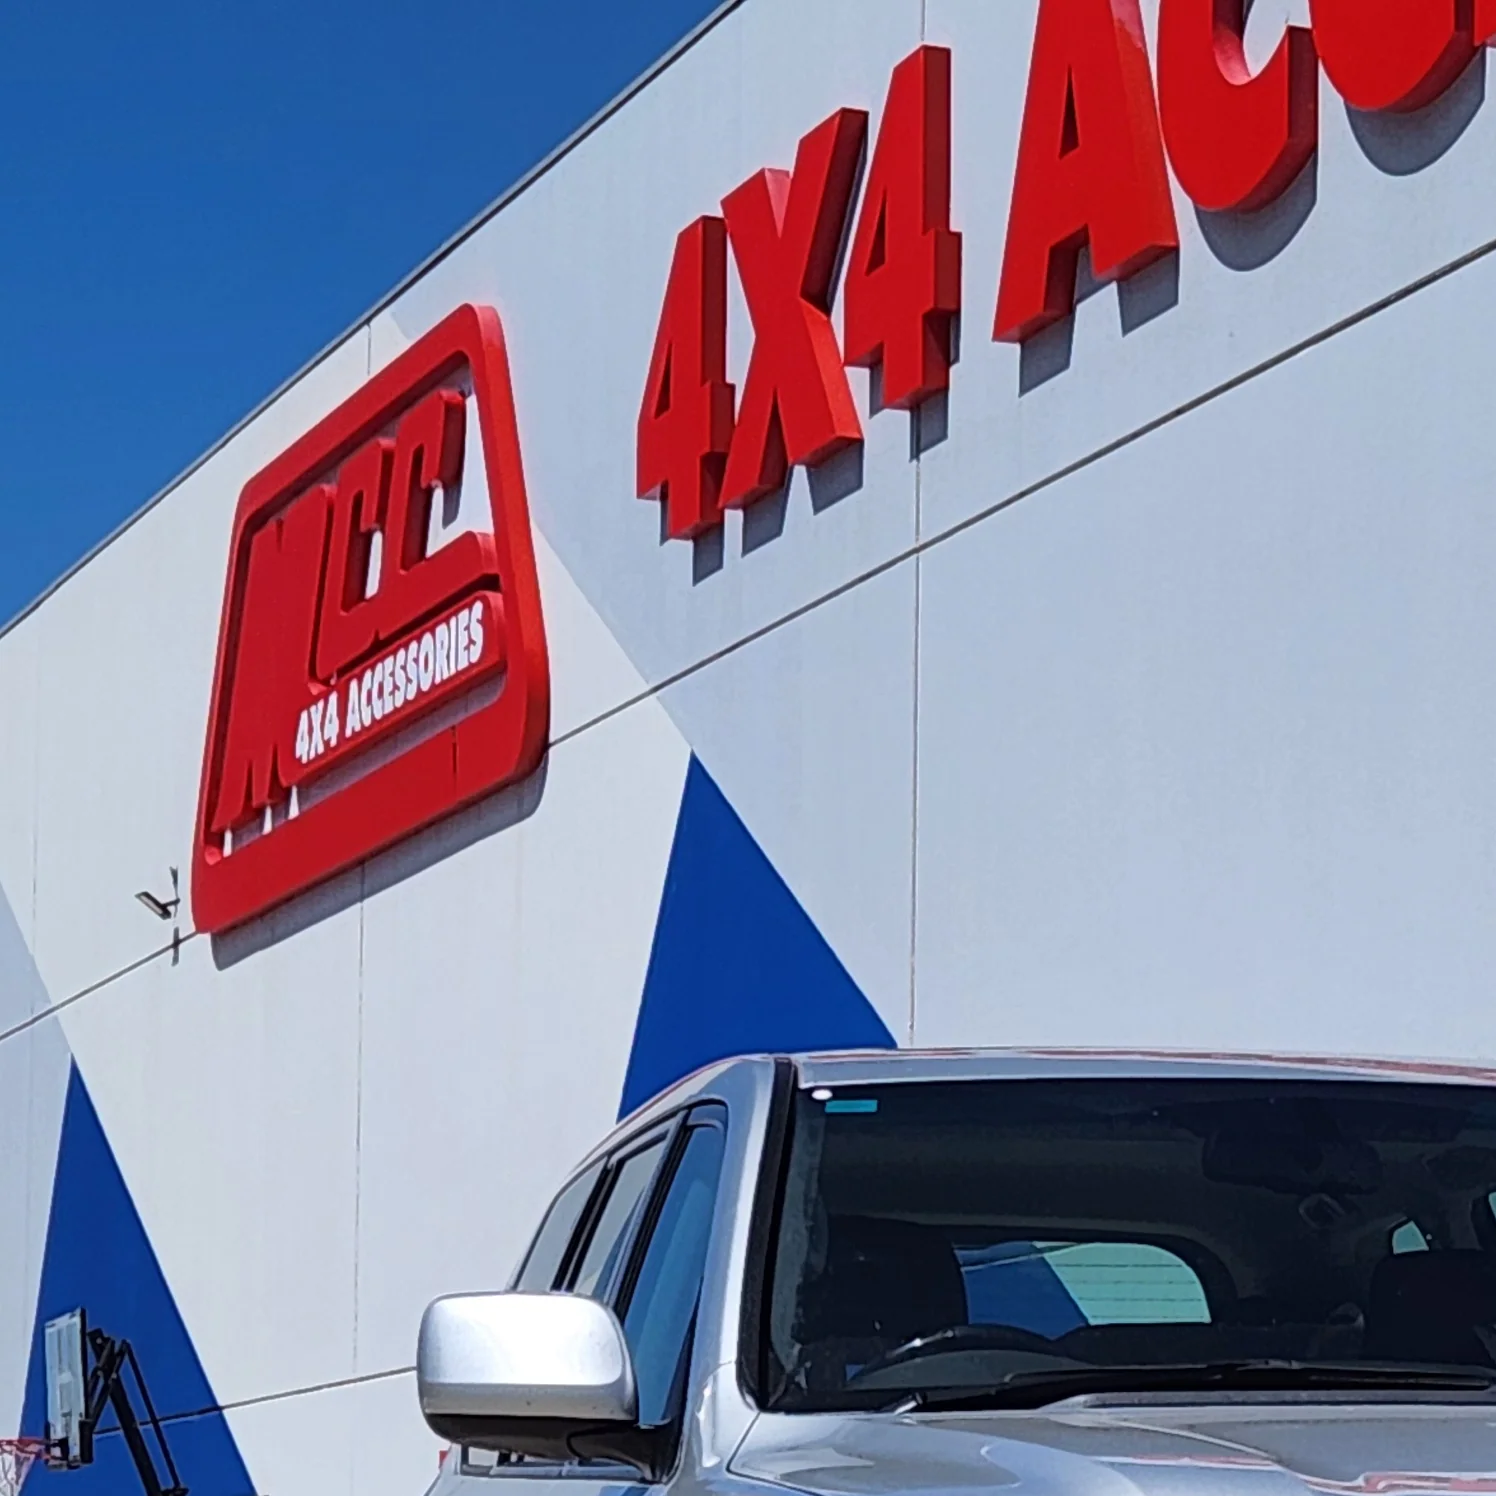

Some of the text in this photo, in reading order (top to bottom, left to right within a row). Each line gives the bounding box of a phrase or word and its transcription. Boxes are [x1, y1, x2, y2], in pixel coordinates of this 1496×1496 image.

[636, 45, 962, 541] 4X4
[211, 388, 502, 834] MCC
[295, 600, 484, 764] 4X4 ACCESSORIES
